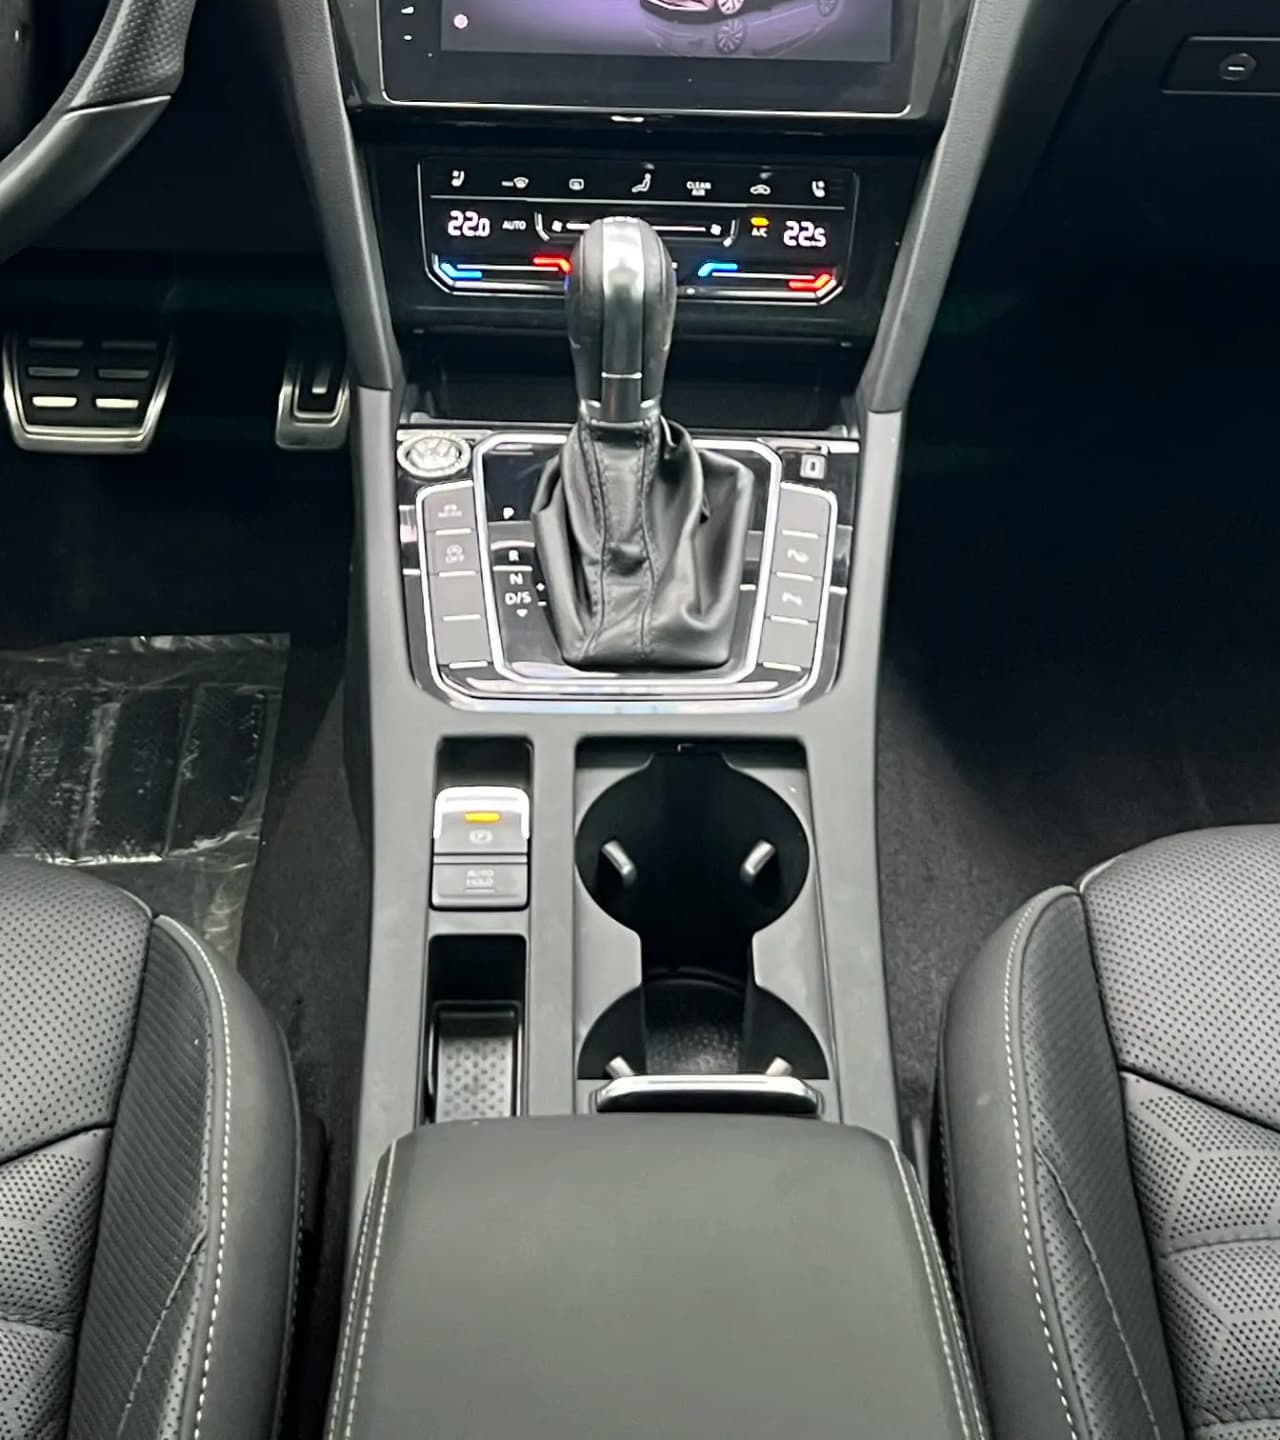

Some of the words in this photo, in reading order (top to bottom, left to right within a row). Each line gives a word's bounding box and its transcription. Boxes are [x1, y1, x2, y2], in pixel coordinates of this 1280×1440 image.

[502, 220, 527, 230] AUTO
[503, 507, 515, 520] P
[508, 550, 520, 561] R
[509, 573, 524, 584] N
[505, 592, 532, 605] D/S
